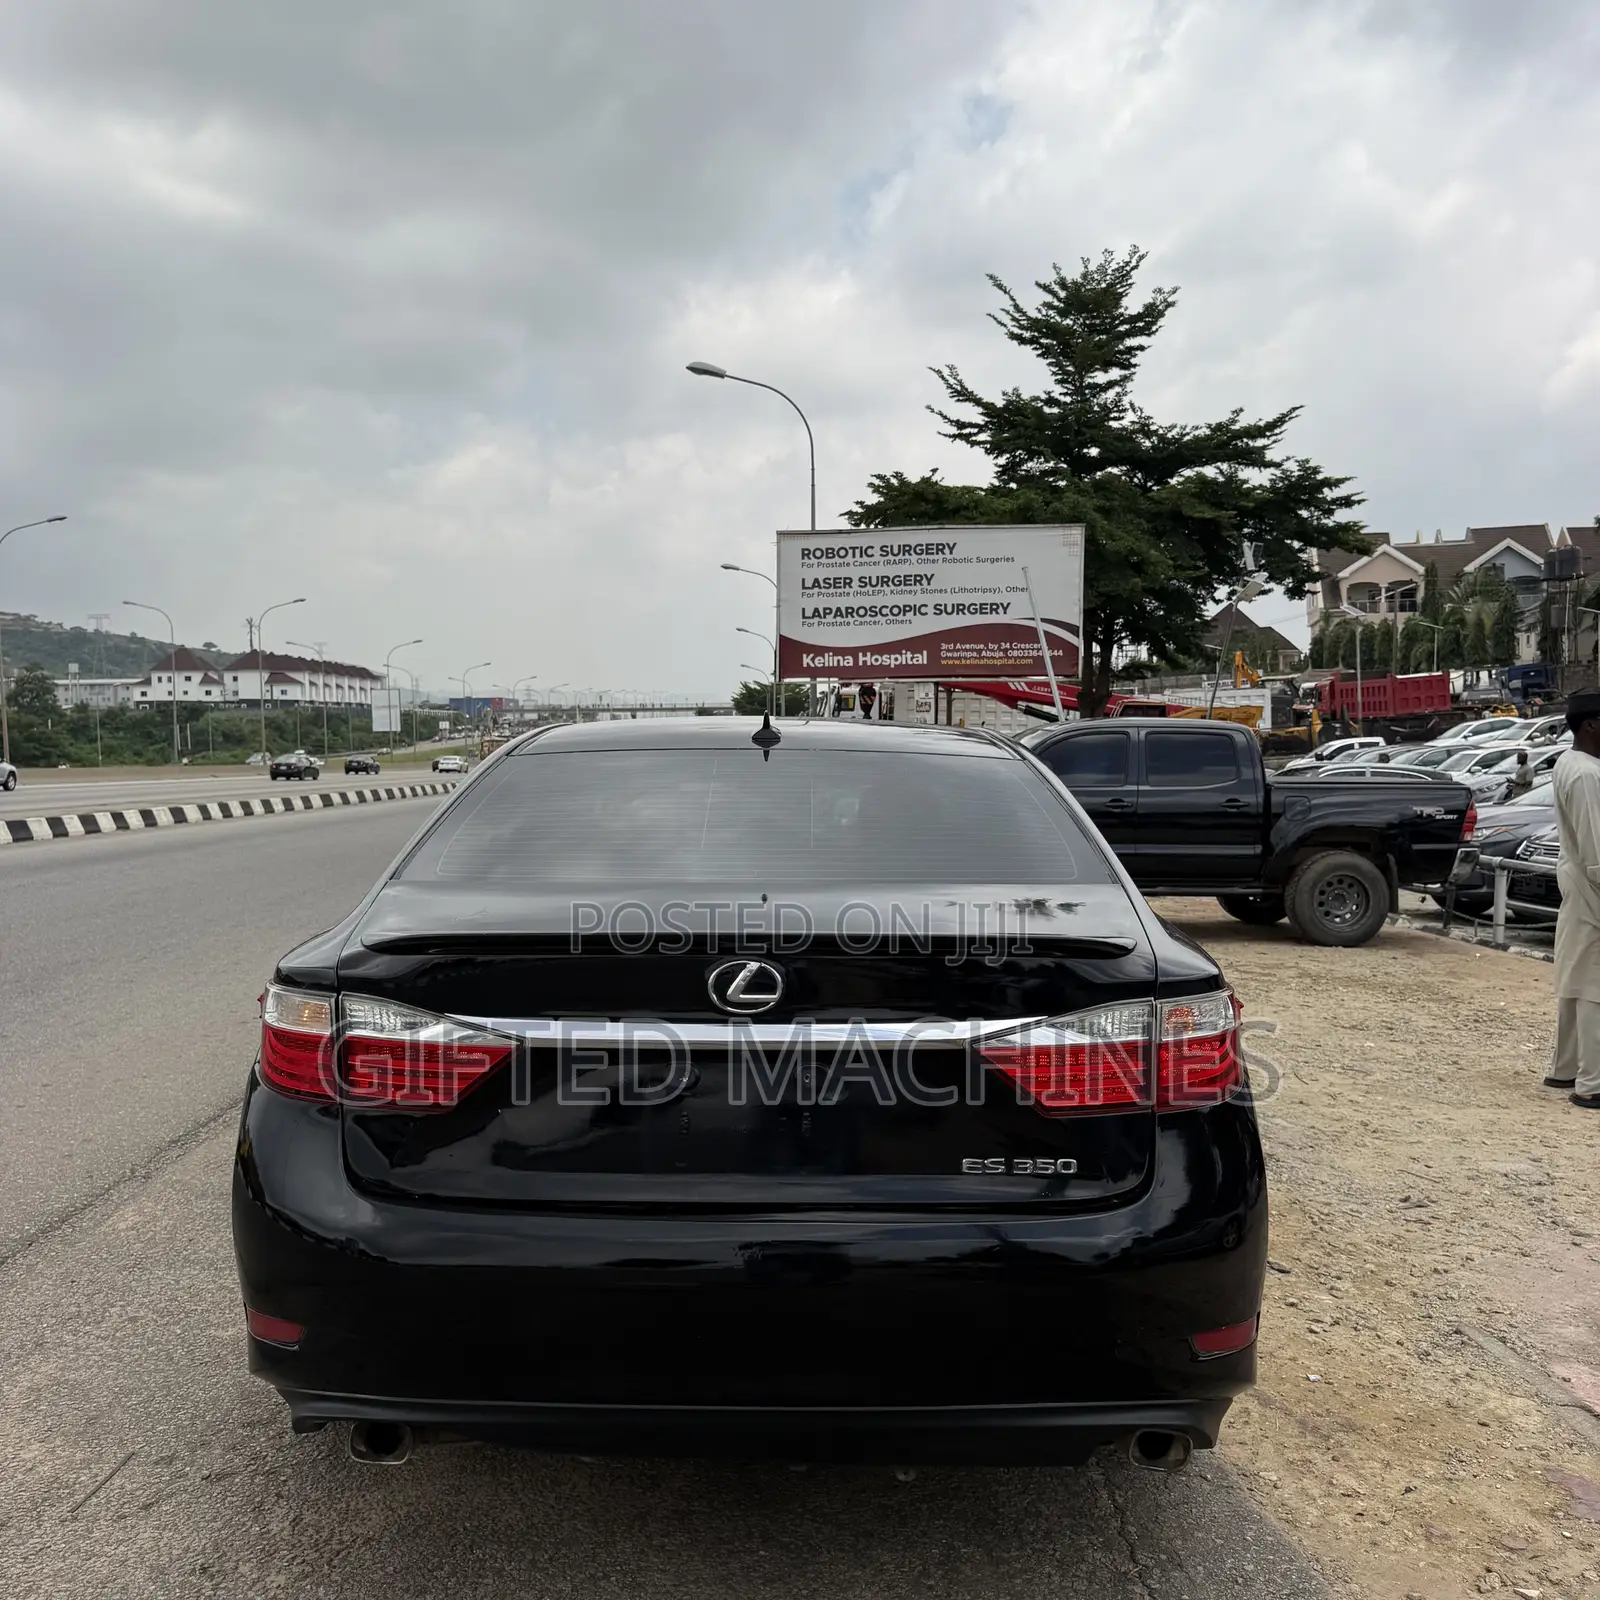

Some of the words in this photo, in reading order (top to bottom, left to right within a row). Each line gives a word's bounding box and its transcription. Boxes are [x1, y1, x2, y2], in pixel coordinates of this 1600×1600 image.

[801, 545, 875, 560] ROBOTIC
[879, 542, 957, 557] SURGERY
[853, 559, 880, 567] Cancer
[916, 557, 939, 565] Other
[942, 556, 973, 564] Robotic
[976, 555, 1015, 564] Surgeries
[801, 576, 853, 590] LASER
[858, 574, 935, 588] SURGERY
[817, 590, 850, 598] Prostate
[890, 588, 918, 596] Kidney
[920, 587, 948, 595] Stones
[801, 604, 928, 620] LAPAROSCOPIC
[933, 602, 1011, 615] SURGERY
[817, 620, 851, 628] Prostate
[853, 619, 884, 627] Cancer,
[885, 618, 912, 626] Others
[940, 642, 954, 650] 3rd
[955, 642, 987, 650] Avenue,
[988, 642, 998, 651] by
[802, 652, 853, 668] Kelina
[858, 650, 927, 668] Hospital
[940, 650, 979, 658] Gwarinpa,
[940, 657, 1033, 665] www.kelinahospital.com
[962, 1158, 1005, 1174] ES
[1013, 1158, 1078, 1174] 350
